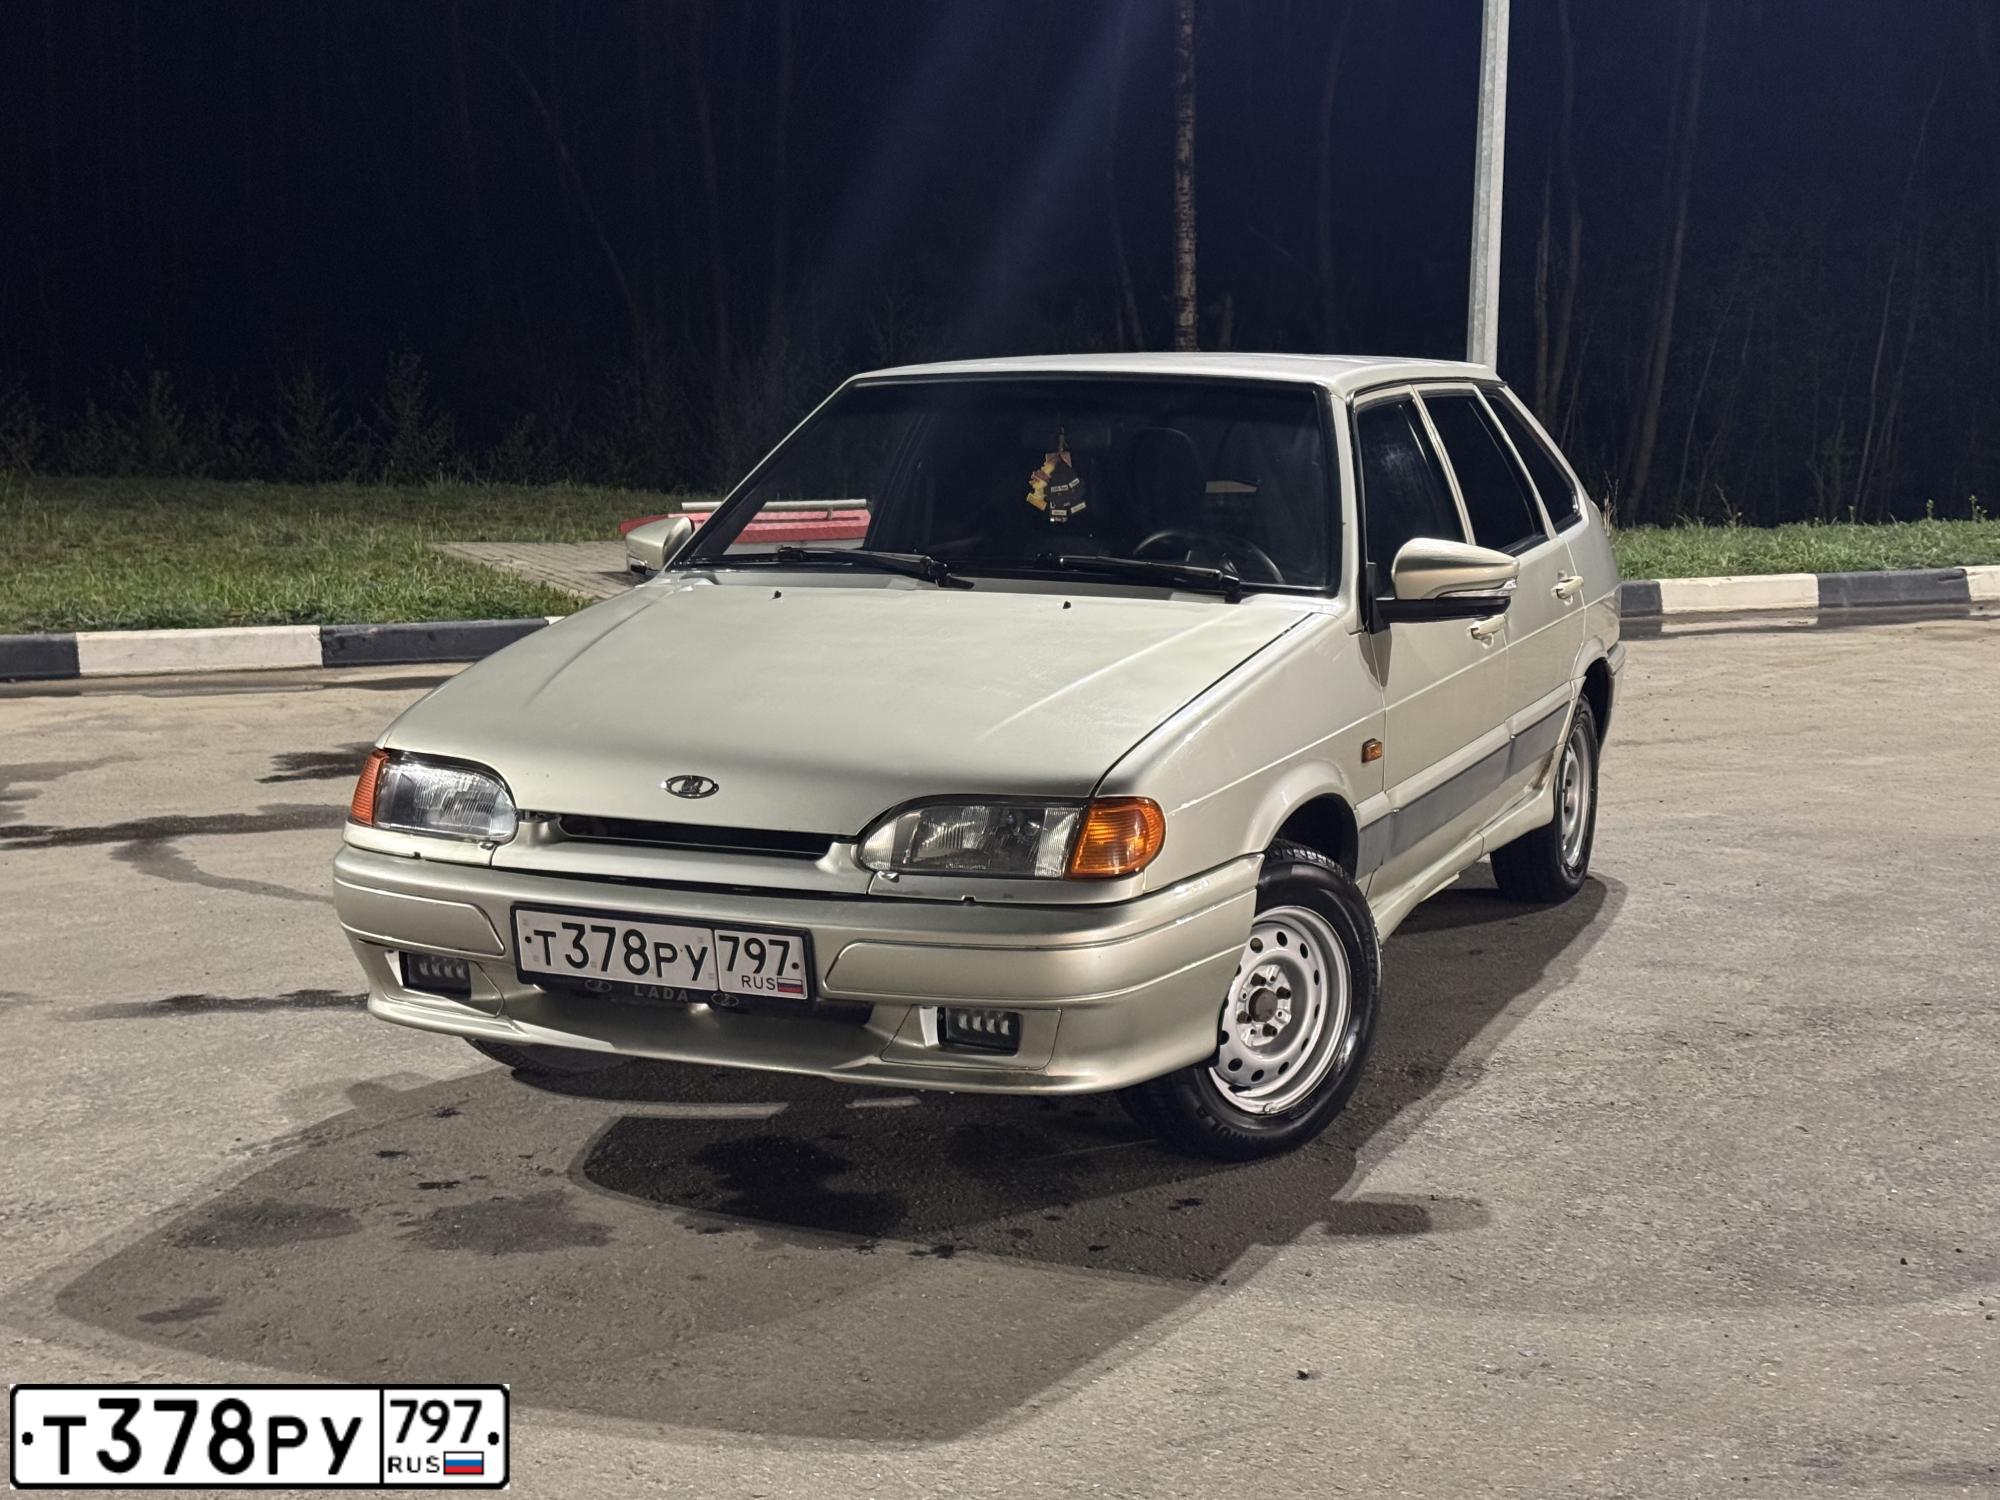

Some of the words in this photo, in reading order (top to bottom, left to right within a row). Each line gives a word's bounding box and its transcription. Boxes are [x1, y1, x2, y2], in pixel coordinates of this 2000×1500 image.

[718, 935, 791, 976] 797
[741, 975, 776, 991] RUS
[634, 985, 688, 1001] LADA
